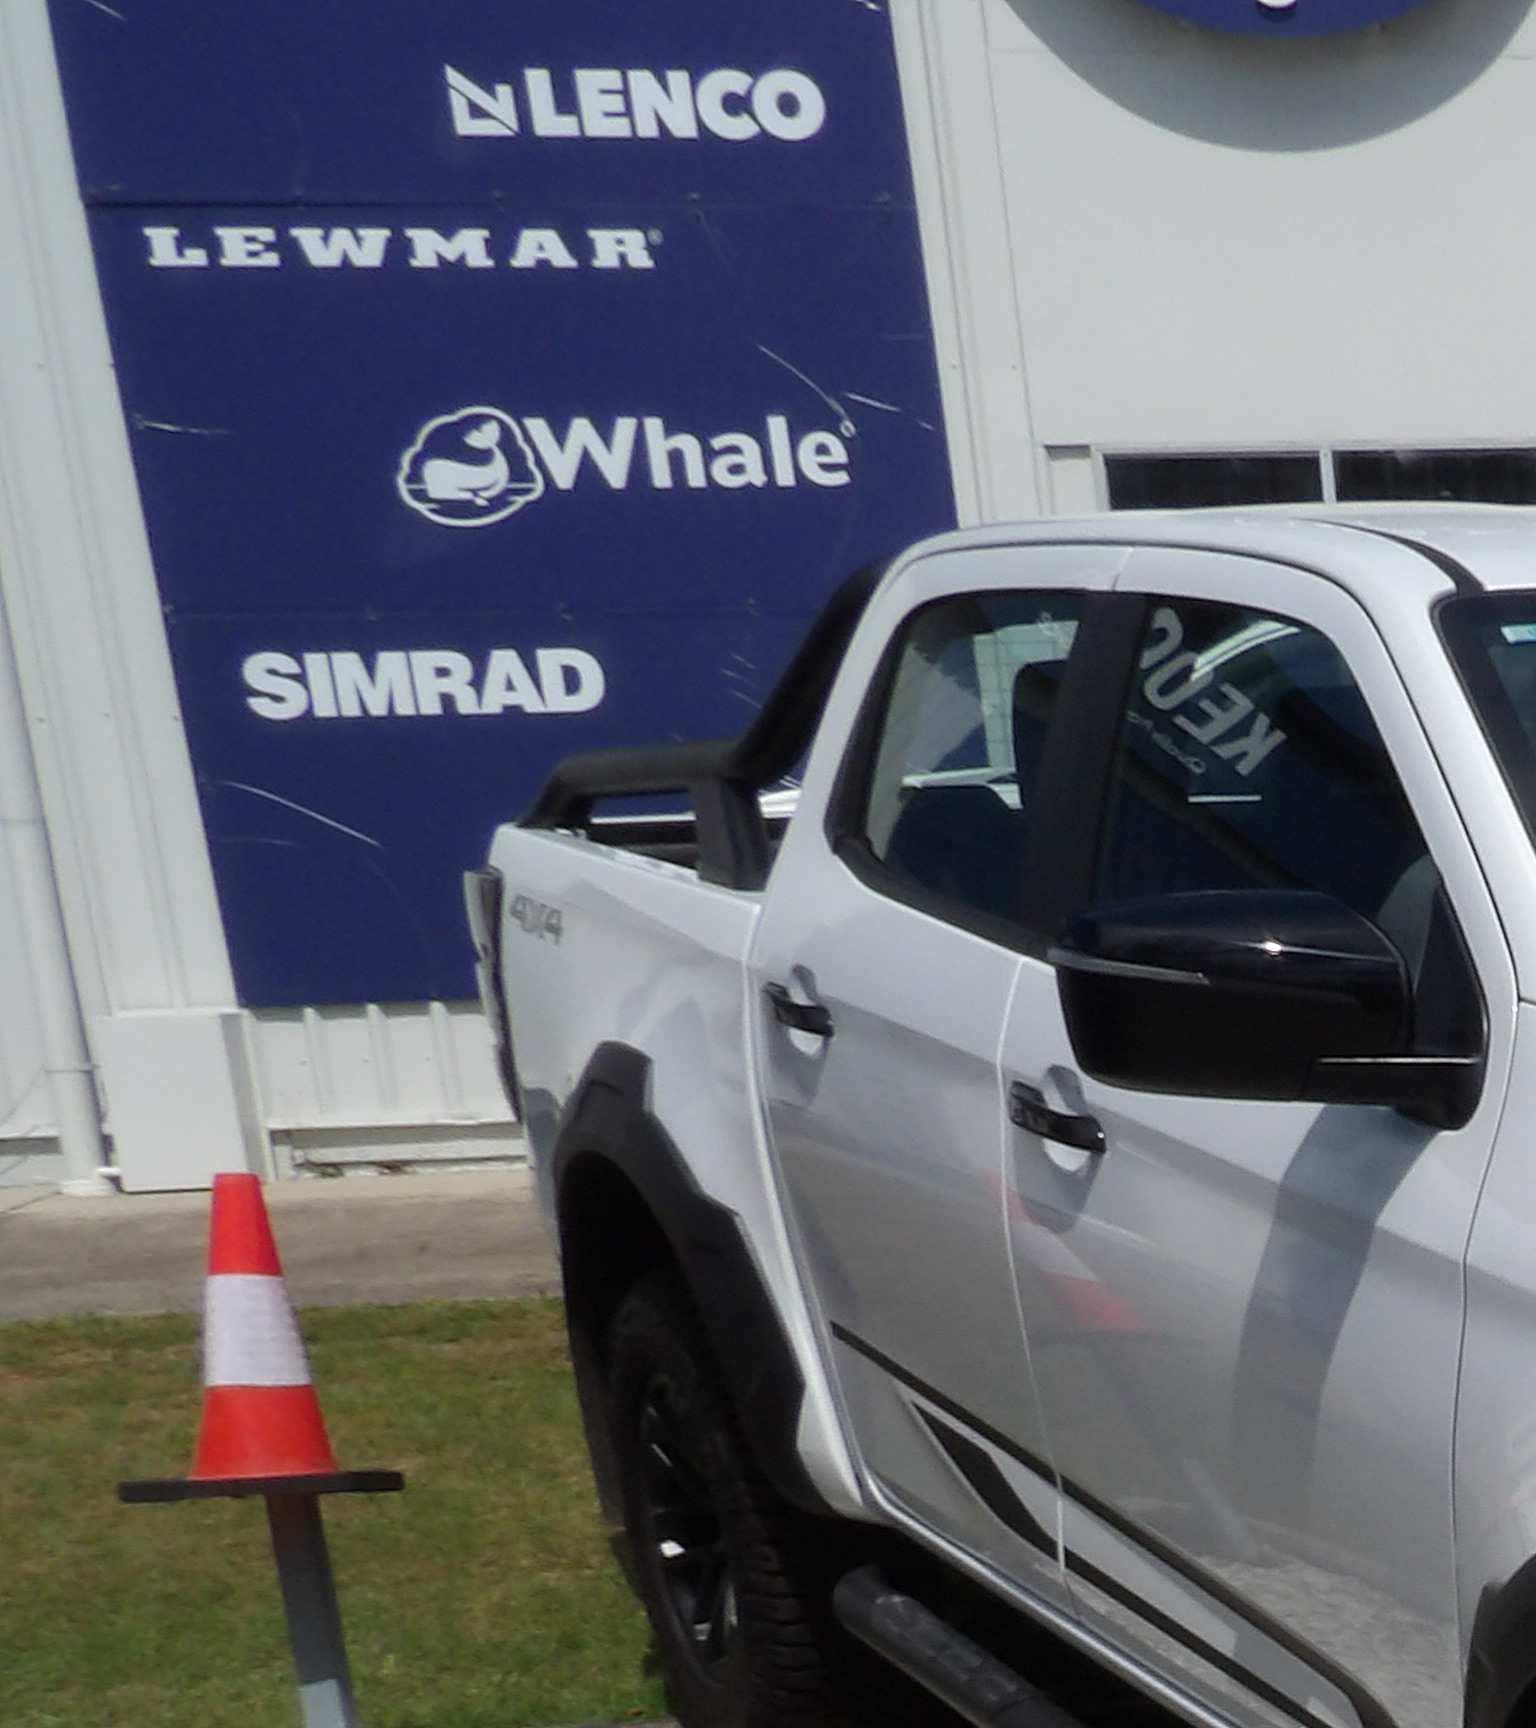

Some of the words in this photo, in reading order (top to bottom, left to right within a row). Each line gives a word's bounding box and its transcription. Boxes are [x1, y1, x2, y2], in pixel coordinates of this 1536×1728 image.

[526, 67, 826, 141] LENCO
[143, 227, 655, 269] LEWMAR
[528, 414, 852, 490] Whale
[242, 648, 606, 721] SIMRAD
